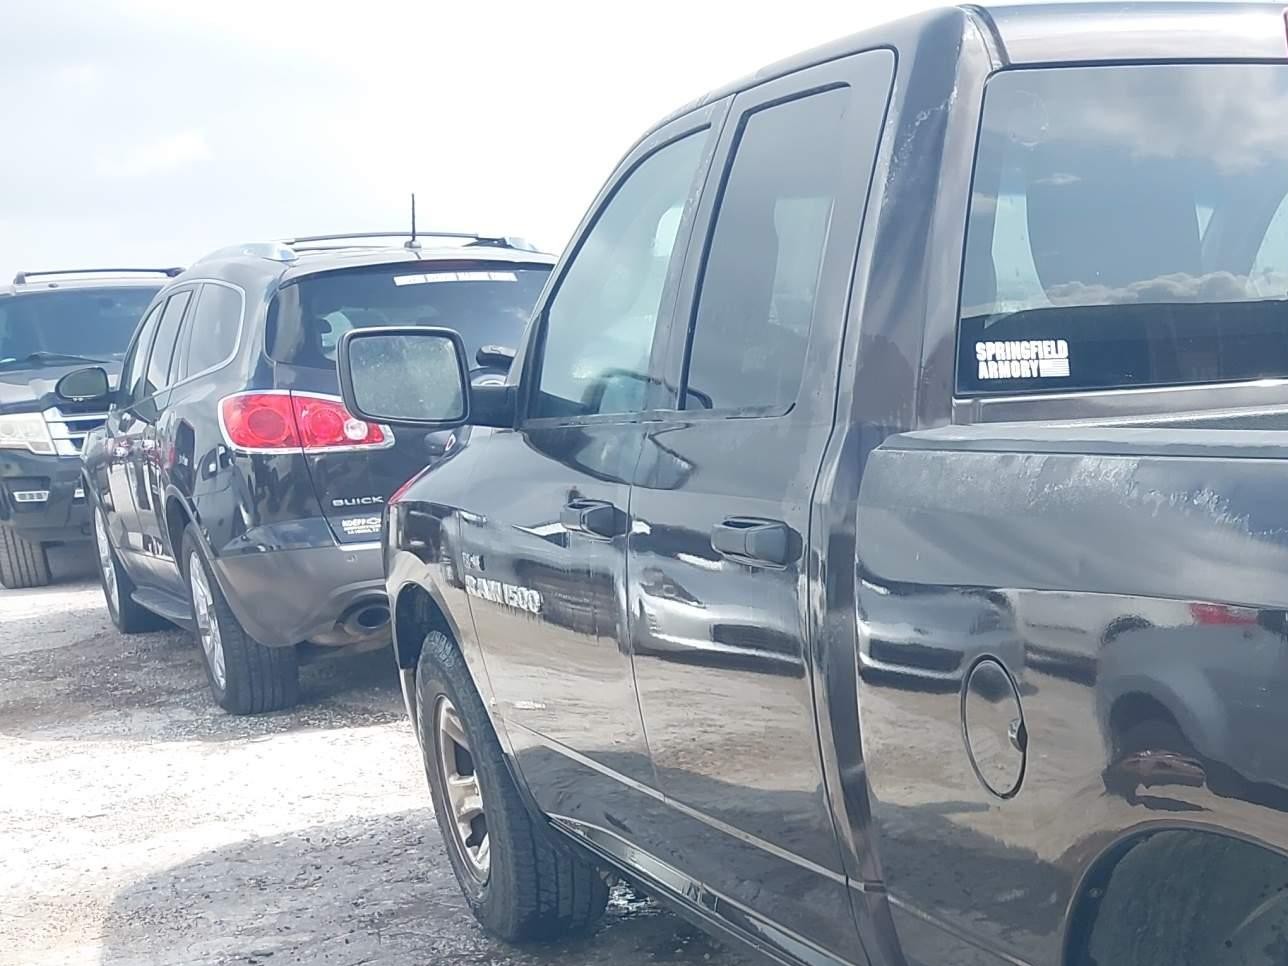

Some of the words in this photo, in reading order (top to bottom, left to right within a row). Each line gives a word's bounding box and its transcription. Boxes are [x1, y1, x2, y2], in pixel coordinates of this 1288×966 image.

[975, 339, 1068, 360] SPRINGFIELD
[978, 359, 1040, 380] ARMORY
[331, 495, 385, 507] BUICK
[464, 574, 503, 604] RAM
[502, 583, 544, 615] 1500
